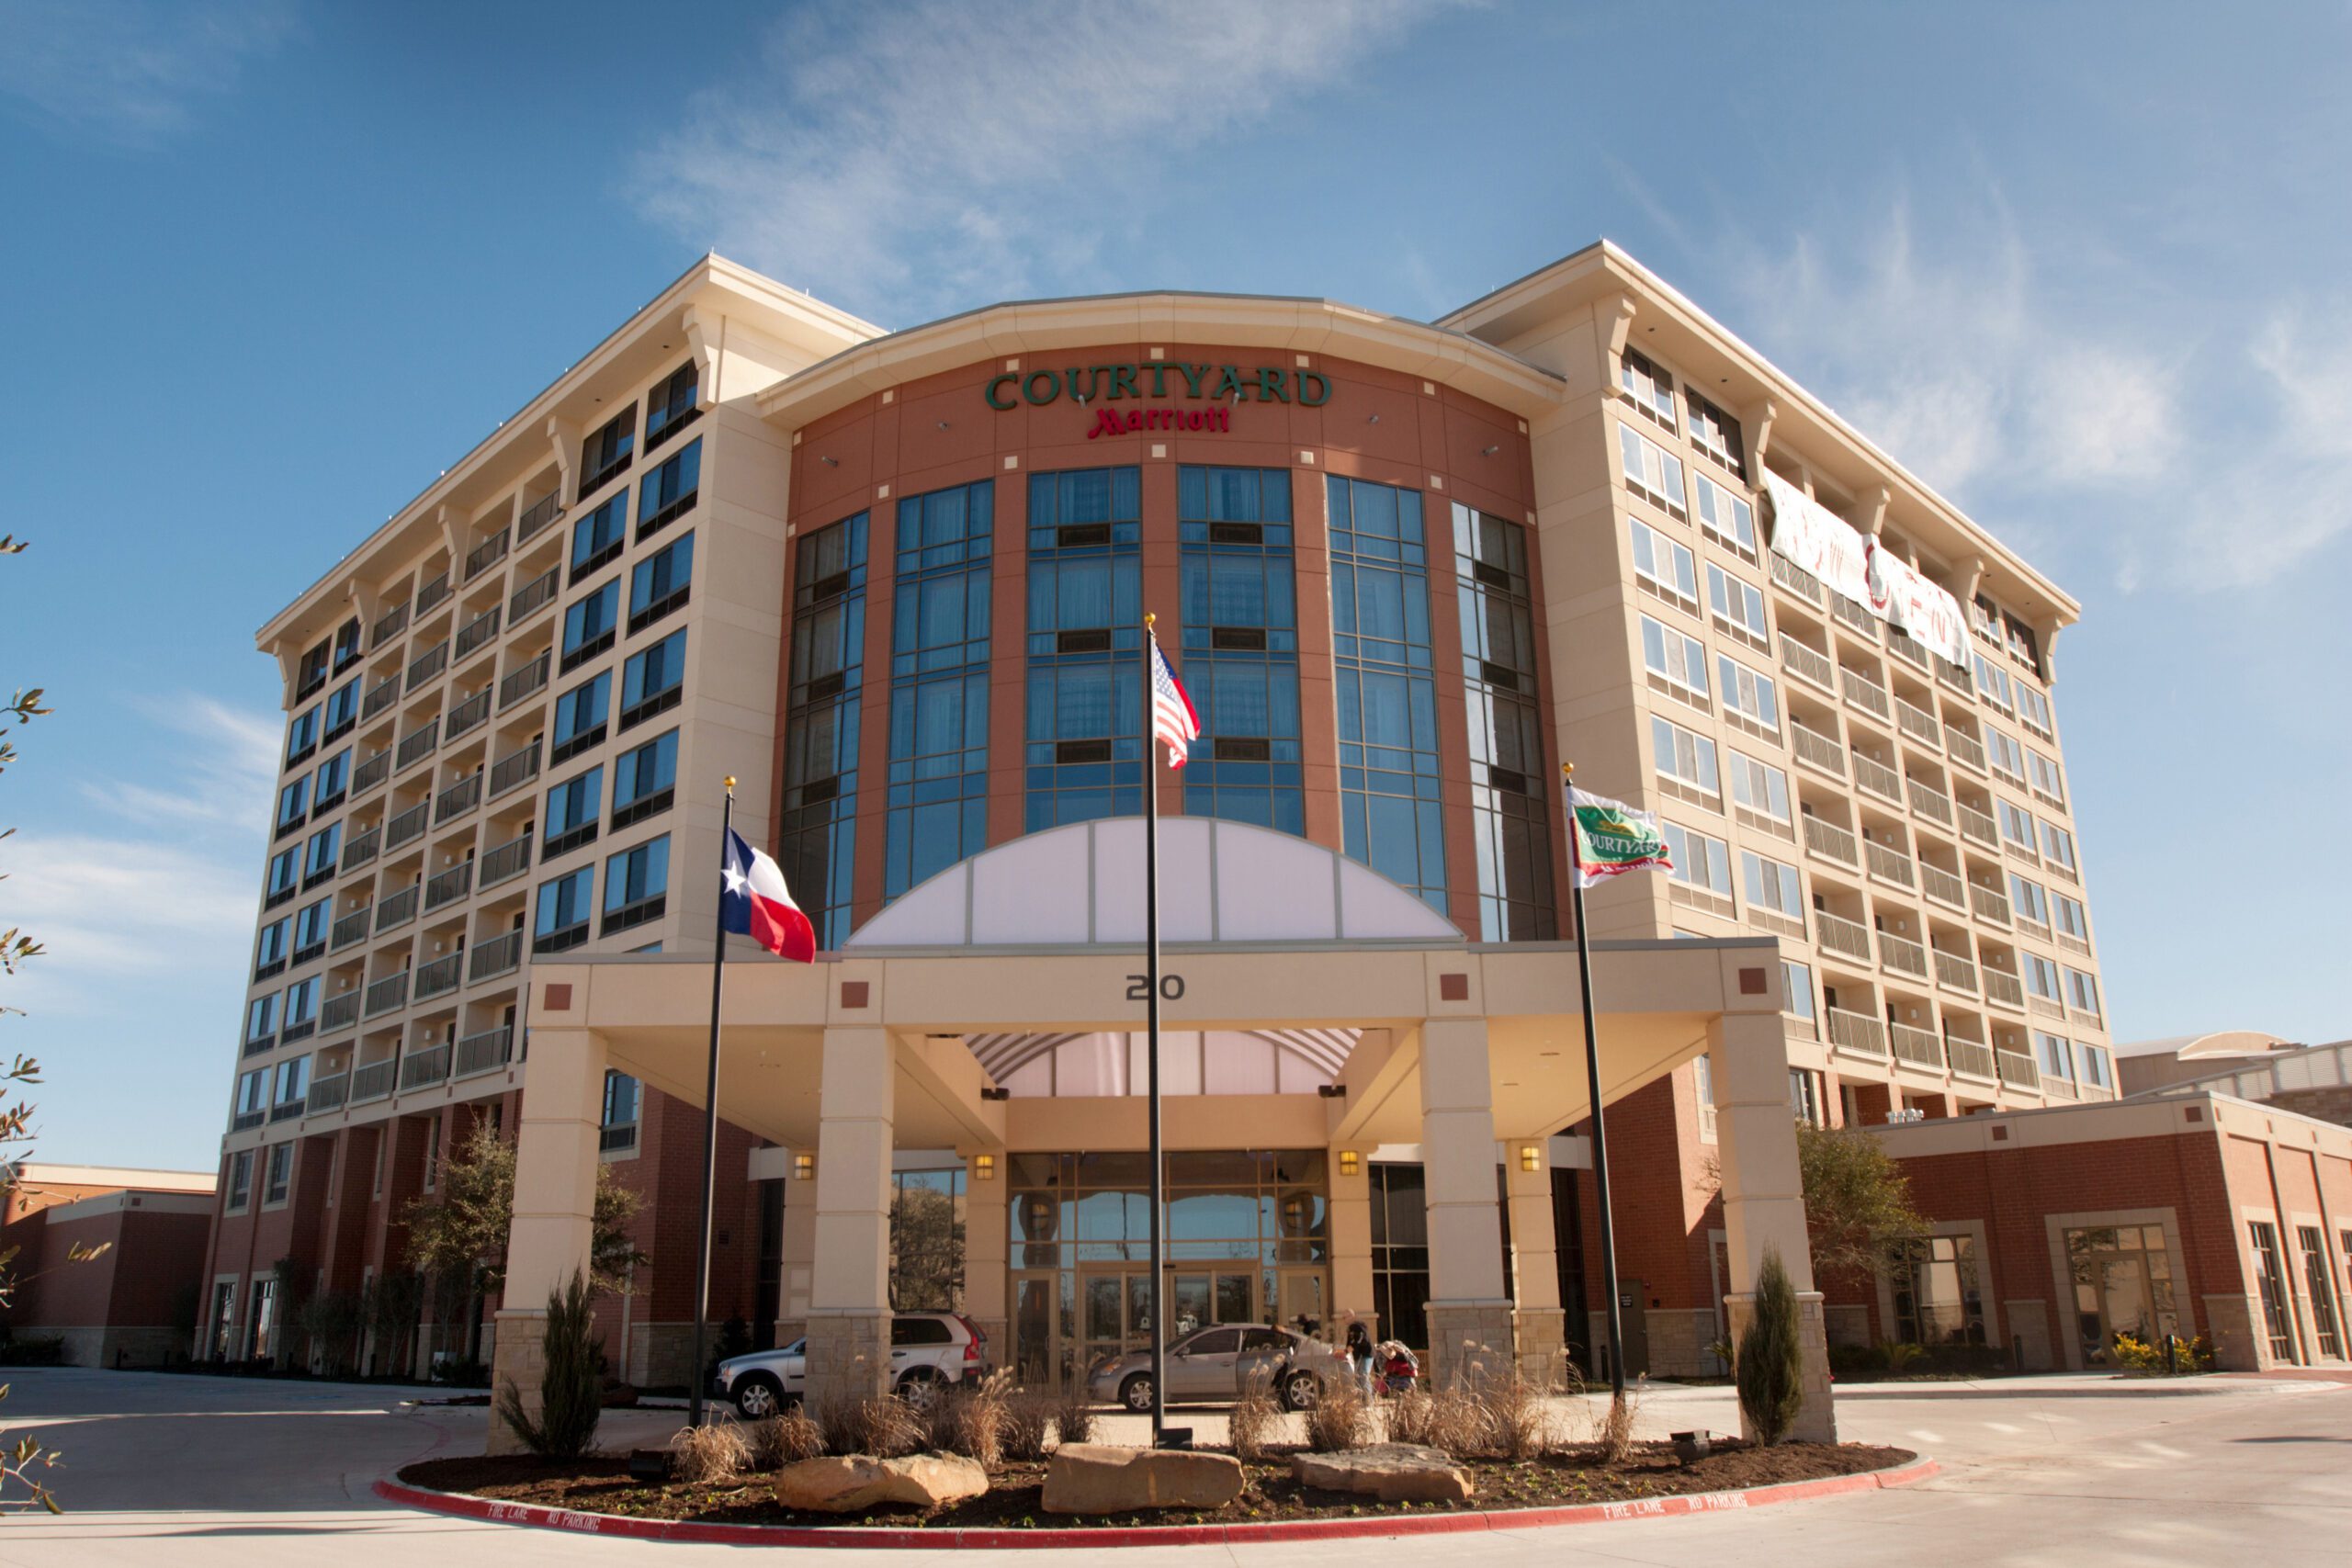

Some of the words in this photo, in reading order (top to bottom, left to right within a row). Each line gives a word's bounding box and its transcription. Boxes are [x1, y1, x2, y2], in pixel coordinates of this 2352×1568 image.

[984, 362, 1333, 411] COURTYARD
[1087, 406, 1230, 439] Marriott
[487, 1504, 503, 1517] FIRE
[507, 1506, 528, 1520] LANE
[546, 1510, 560, 1525] NO
[561, 1512, 602, 1531] PARKING
[1602, 1504, 1632, 1519] FIRE
[1634, 1499, 1665, 1515] LANE
[1686, 1496, 1702, 1511] NO
[1705, 1493, 1748, 1509] PARKING
